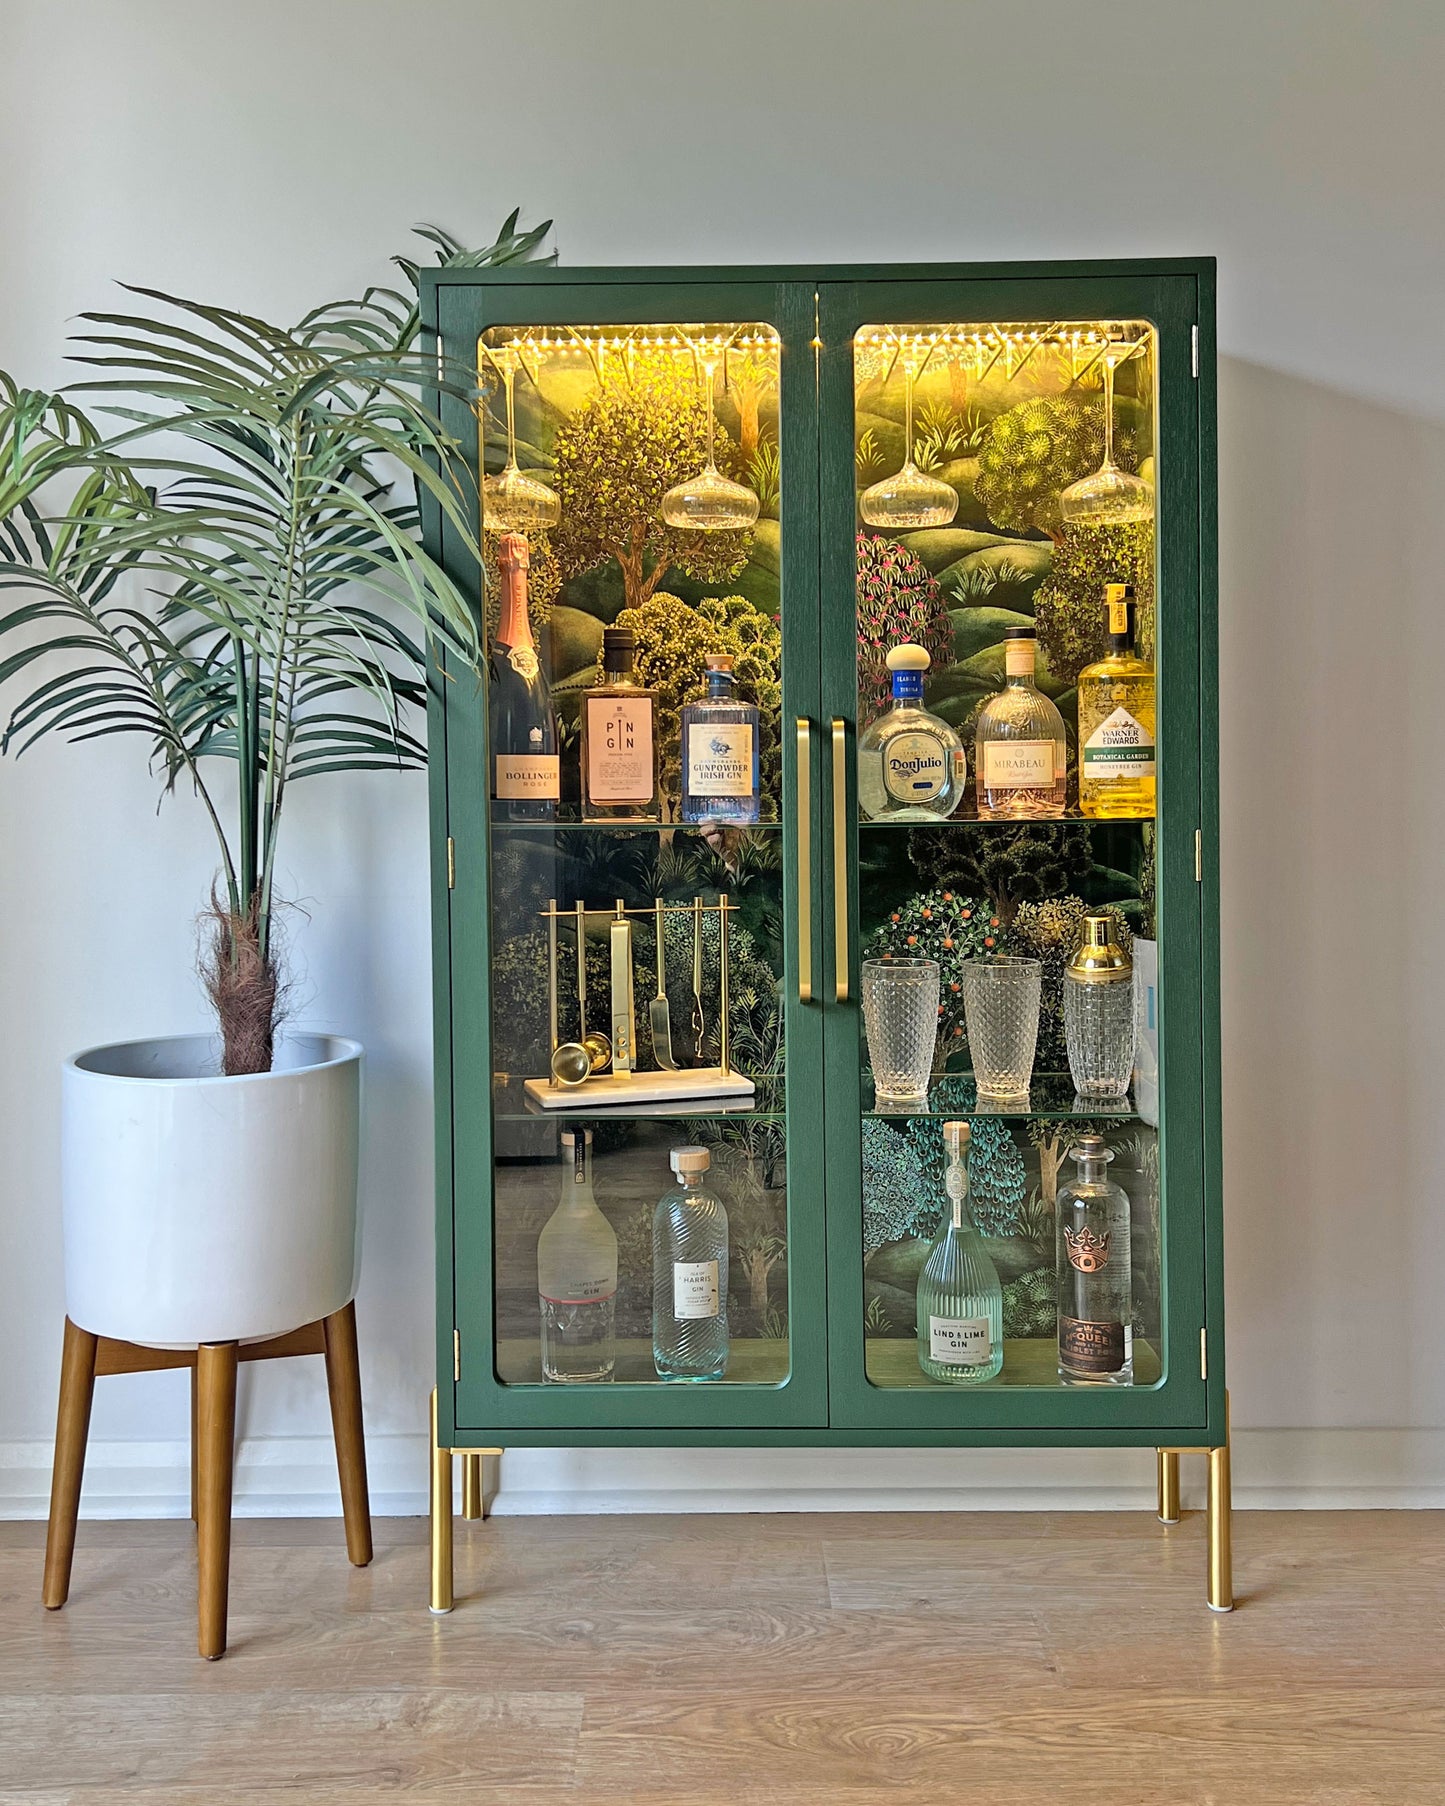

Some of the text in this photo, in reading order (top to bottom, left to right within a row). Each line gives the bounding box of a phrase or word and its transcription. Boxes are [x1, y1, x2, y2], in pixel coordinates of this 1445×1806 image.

[1102, 737, 1139, 745] EDWARDS
[693, 764, 748, 772] GUNPOWDER
[994, 760, 1045, 768] MIRABEAU
[684, 1275, 712, 1283] HARRIS
[583, 1287, 600, 1295] GIN
[933, 1329, 954, 1338] LIND
[964, 1330, 985, 1339] LIME
